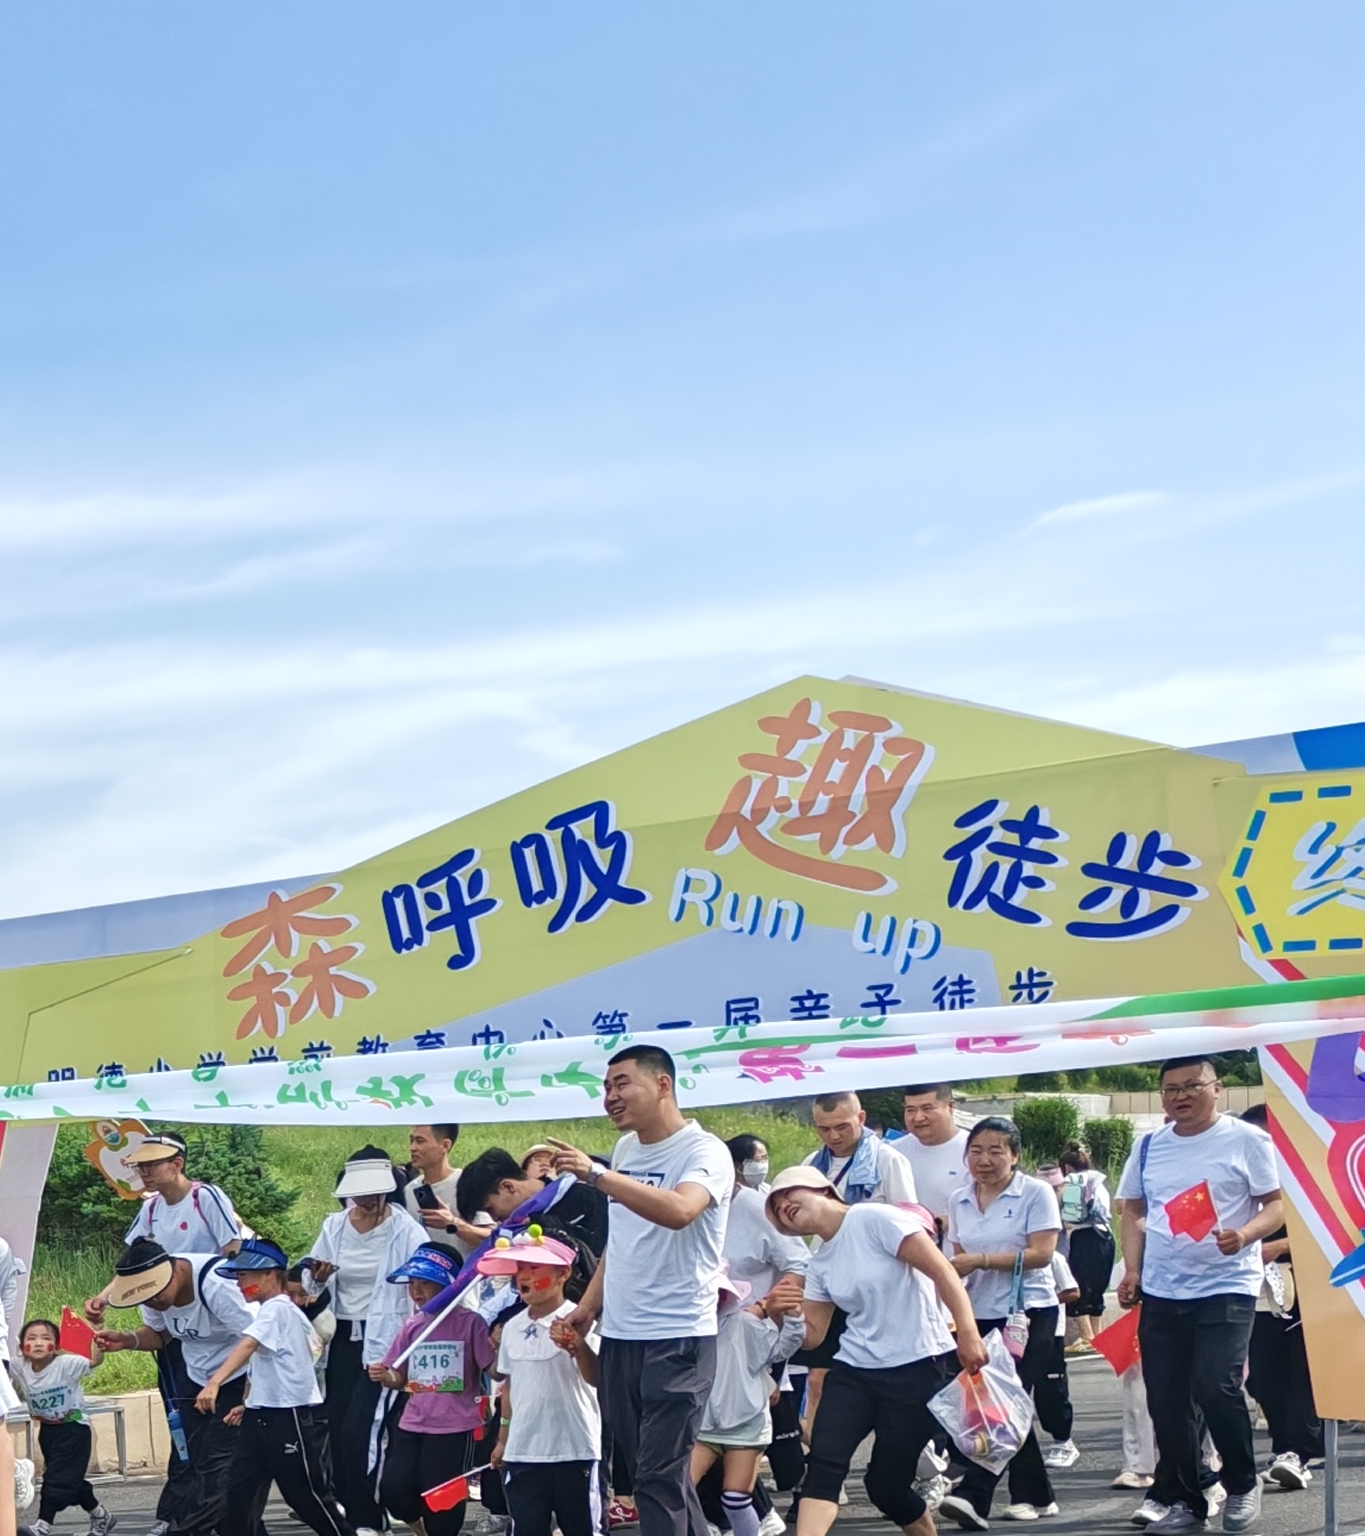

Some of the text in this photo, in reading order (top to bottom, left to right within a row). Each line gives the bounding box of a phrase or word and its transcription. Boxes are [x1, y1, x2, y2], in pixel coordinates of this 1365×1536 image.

[670, 866, 942, 974] Run up
[31, 1393, 65, 1410] A227
